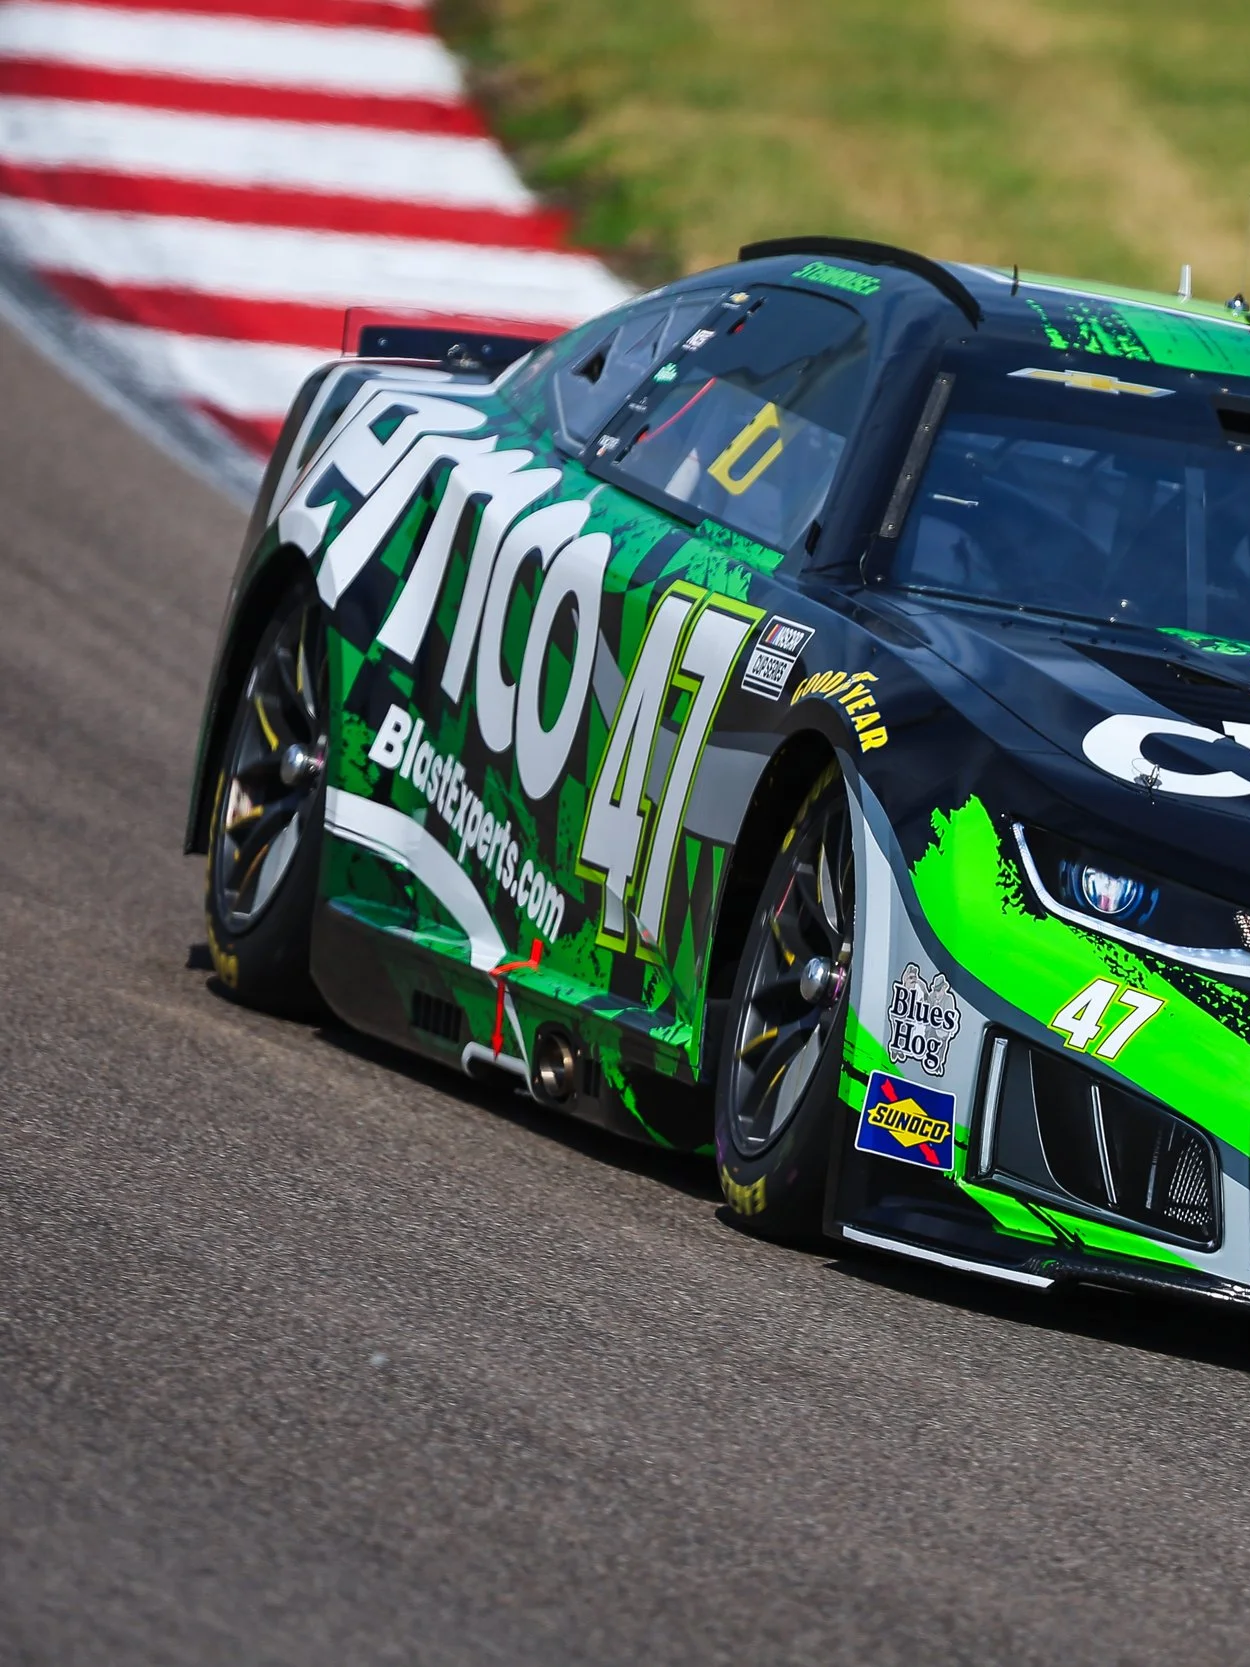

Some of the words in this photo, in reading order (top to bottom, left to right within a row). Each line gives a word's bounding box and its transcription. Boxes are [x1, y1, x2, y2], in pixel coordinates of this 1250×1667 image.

[575, 579, 767, 966] 47
[368, 703, 565, 944] BlastExperts.com
[891, 983, 956, 1031] Blues
[1048, 975, 1166, 1060] 47
[893, 1019, 942, 1070] Hog
[868, 1104, 949, 1142] SUNOCO
